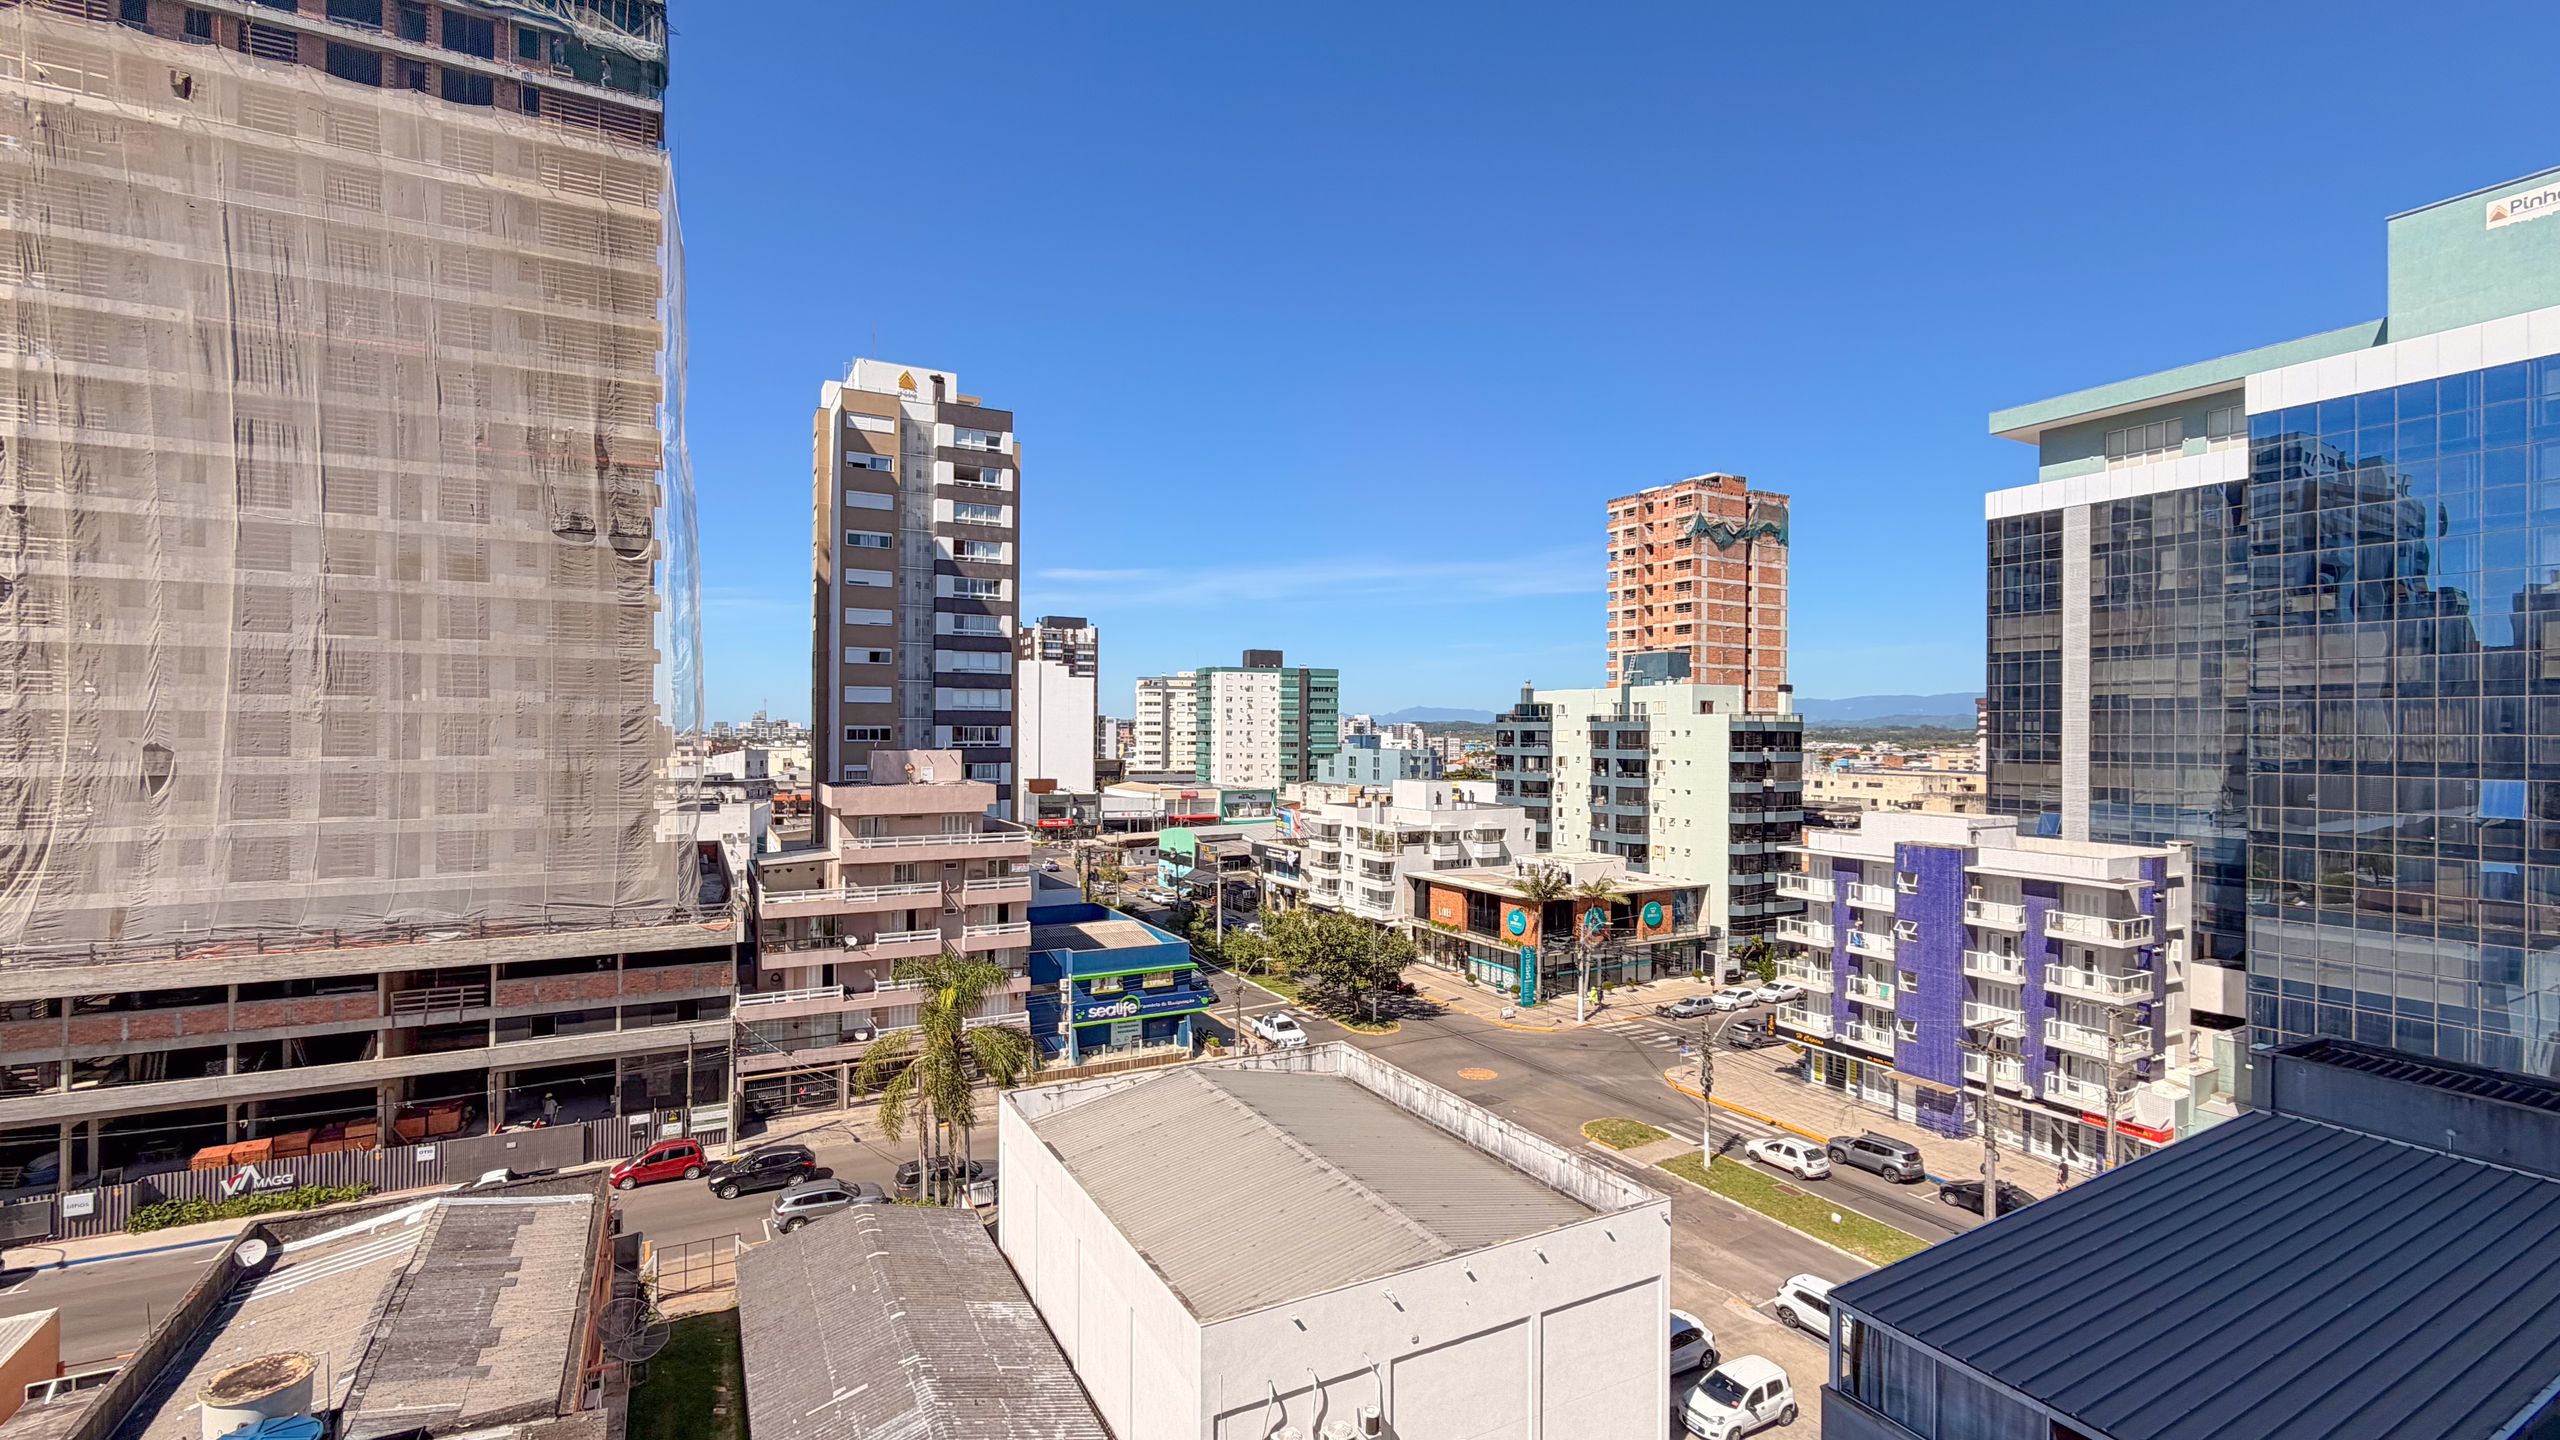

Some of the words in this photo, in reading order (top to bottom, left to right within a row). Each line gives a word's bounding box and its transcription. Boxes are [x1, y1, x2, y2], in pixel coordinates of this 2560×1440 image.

[2510, 190, 2560, 214] Pinh
[1088, 1001, 1138, 1018] sealife
[253, 1173, 295, 1189] MAGGI
